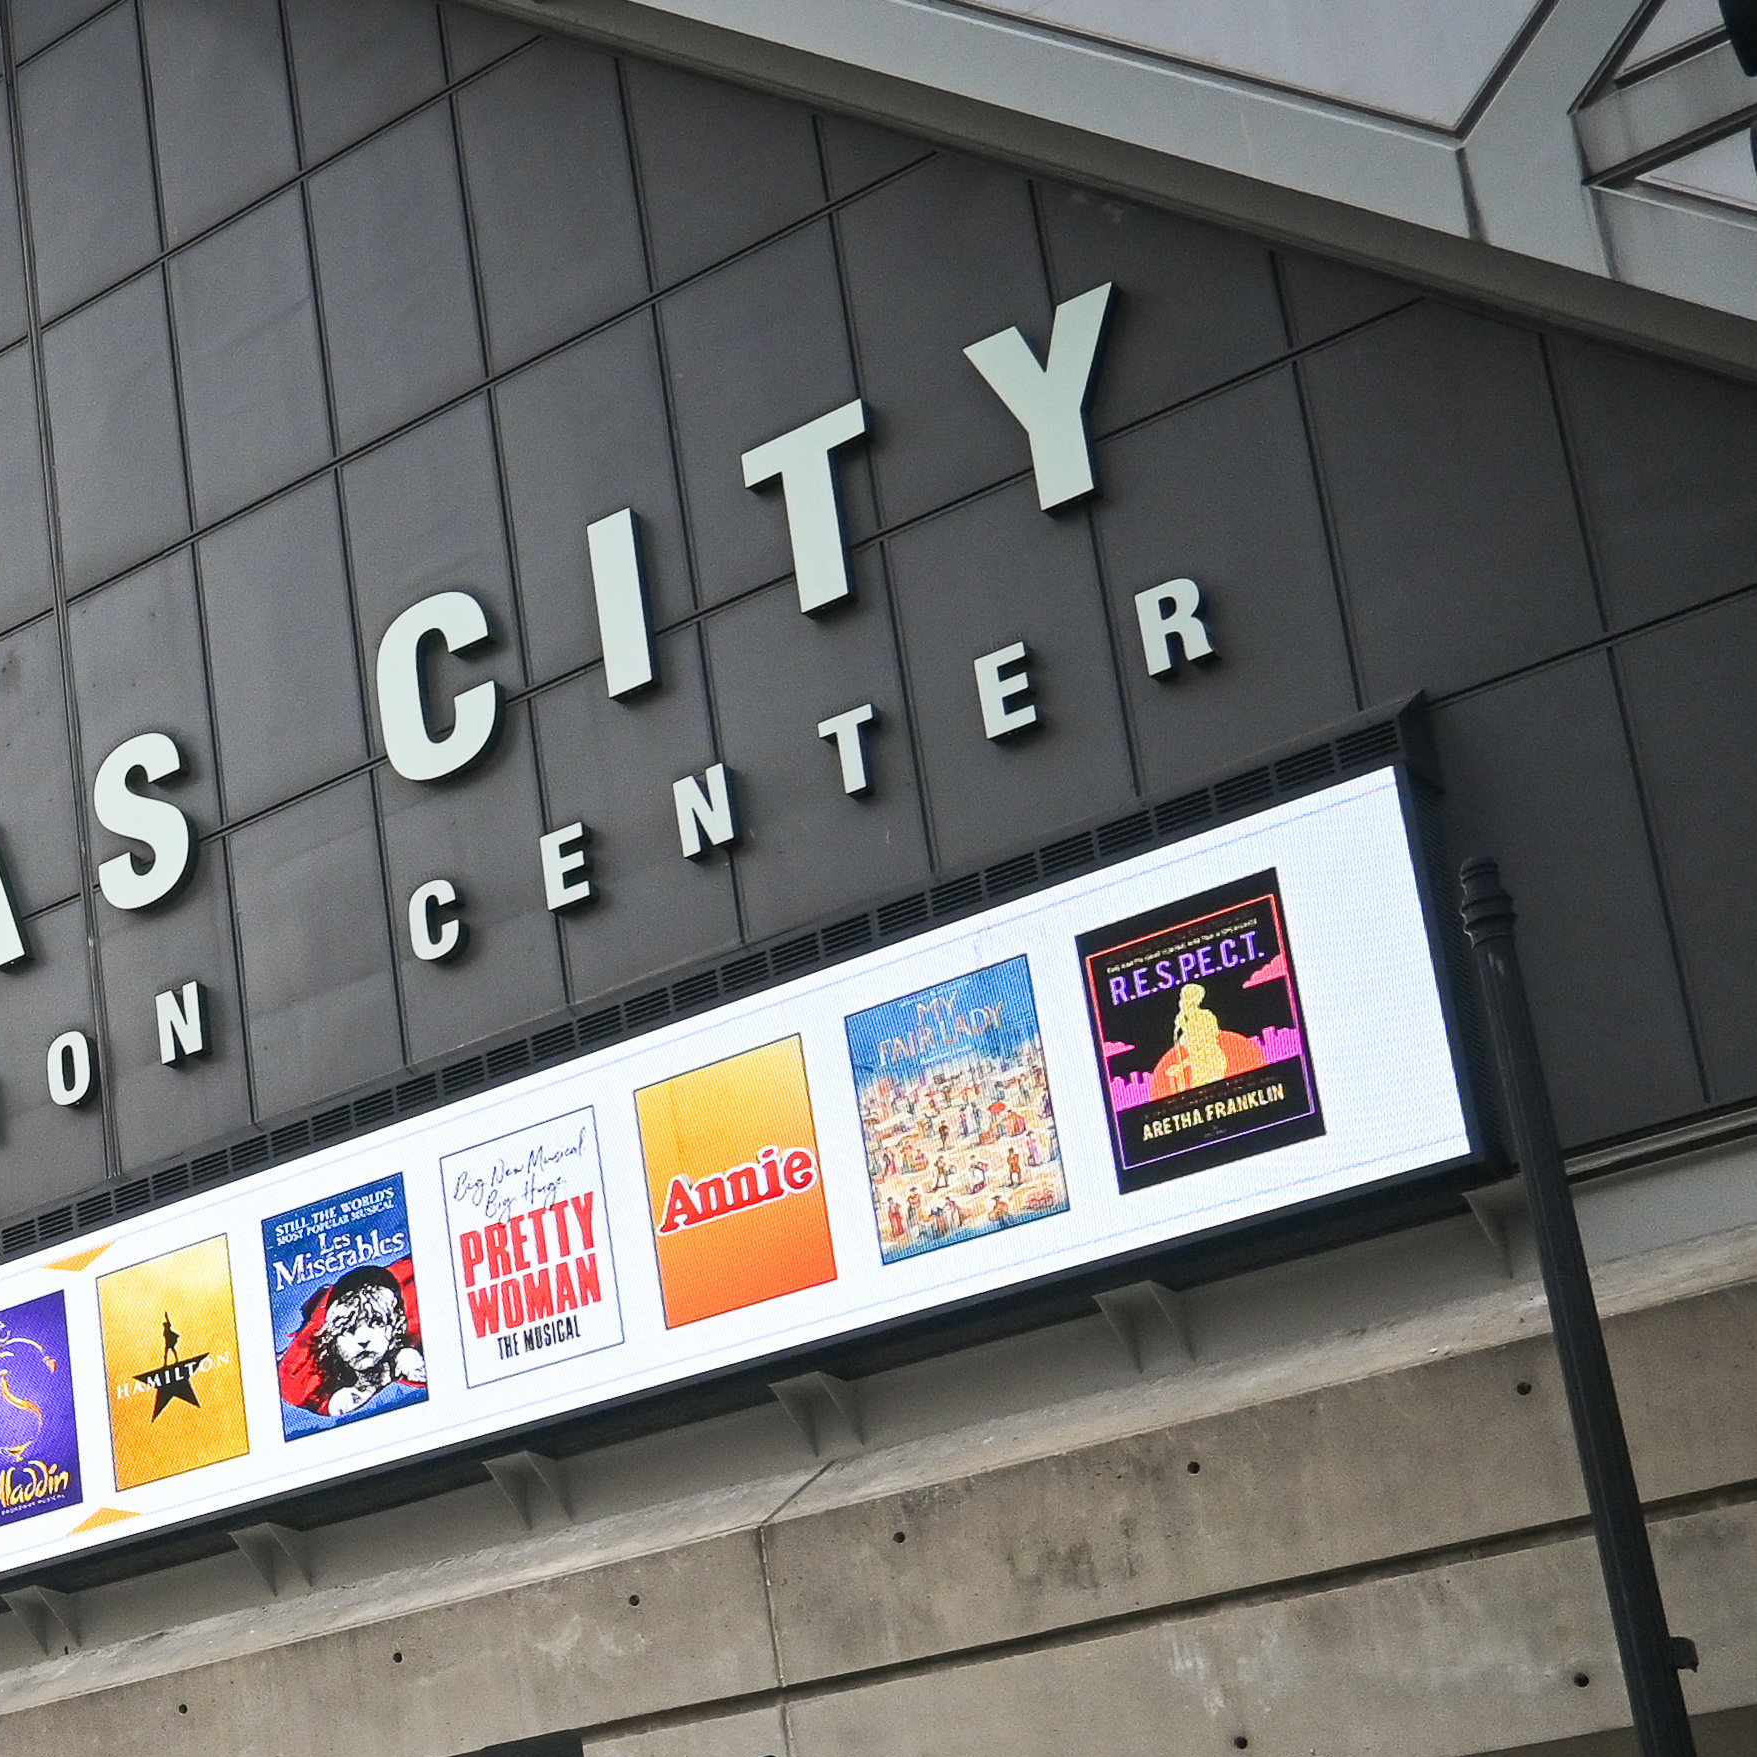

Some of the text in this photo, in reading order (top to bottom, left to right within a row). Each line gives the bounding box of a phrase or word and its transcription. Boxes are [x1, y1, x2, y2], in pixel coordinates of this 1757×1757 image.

[375, 280, 1115, 781] CITY
[407, 577, 1214, 961] CENTER
[1108, 931, 1266, 1006] R.E.S.P.E.C.T.
[878, 1026, 936, 1067] FAIR
[941, 999, 1005, 1045] LADY
[915, 989, 958, 1027] MY
[1142, 1108, 1205, 1141] ARETHA
[1204, 1083, 1286, 1122] FRANKLIN
[274, 1216, 309, 1237] STILL
[310, 1206, 337, 1225] THE
[657, 1147, 815, 1235] Annie
[272, 1228, 406, 1292] Misérables
[317, 1231, 352, 1252] Les
[459, 1191, 595, 1288] PRETTY
[467, 1252, 602, 1339] WOMAN
[497, 1314, 581, 1360] THE MUSICAL
[115, 1351, 231, 1400] HAMILTON
